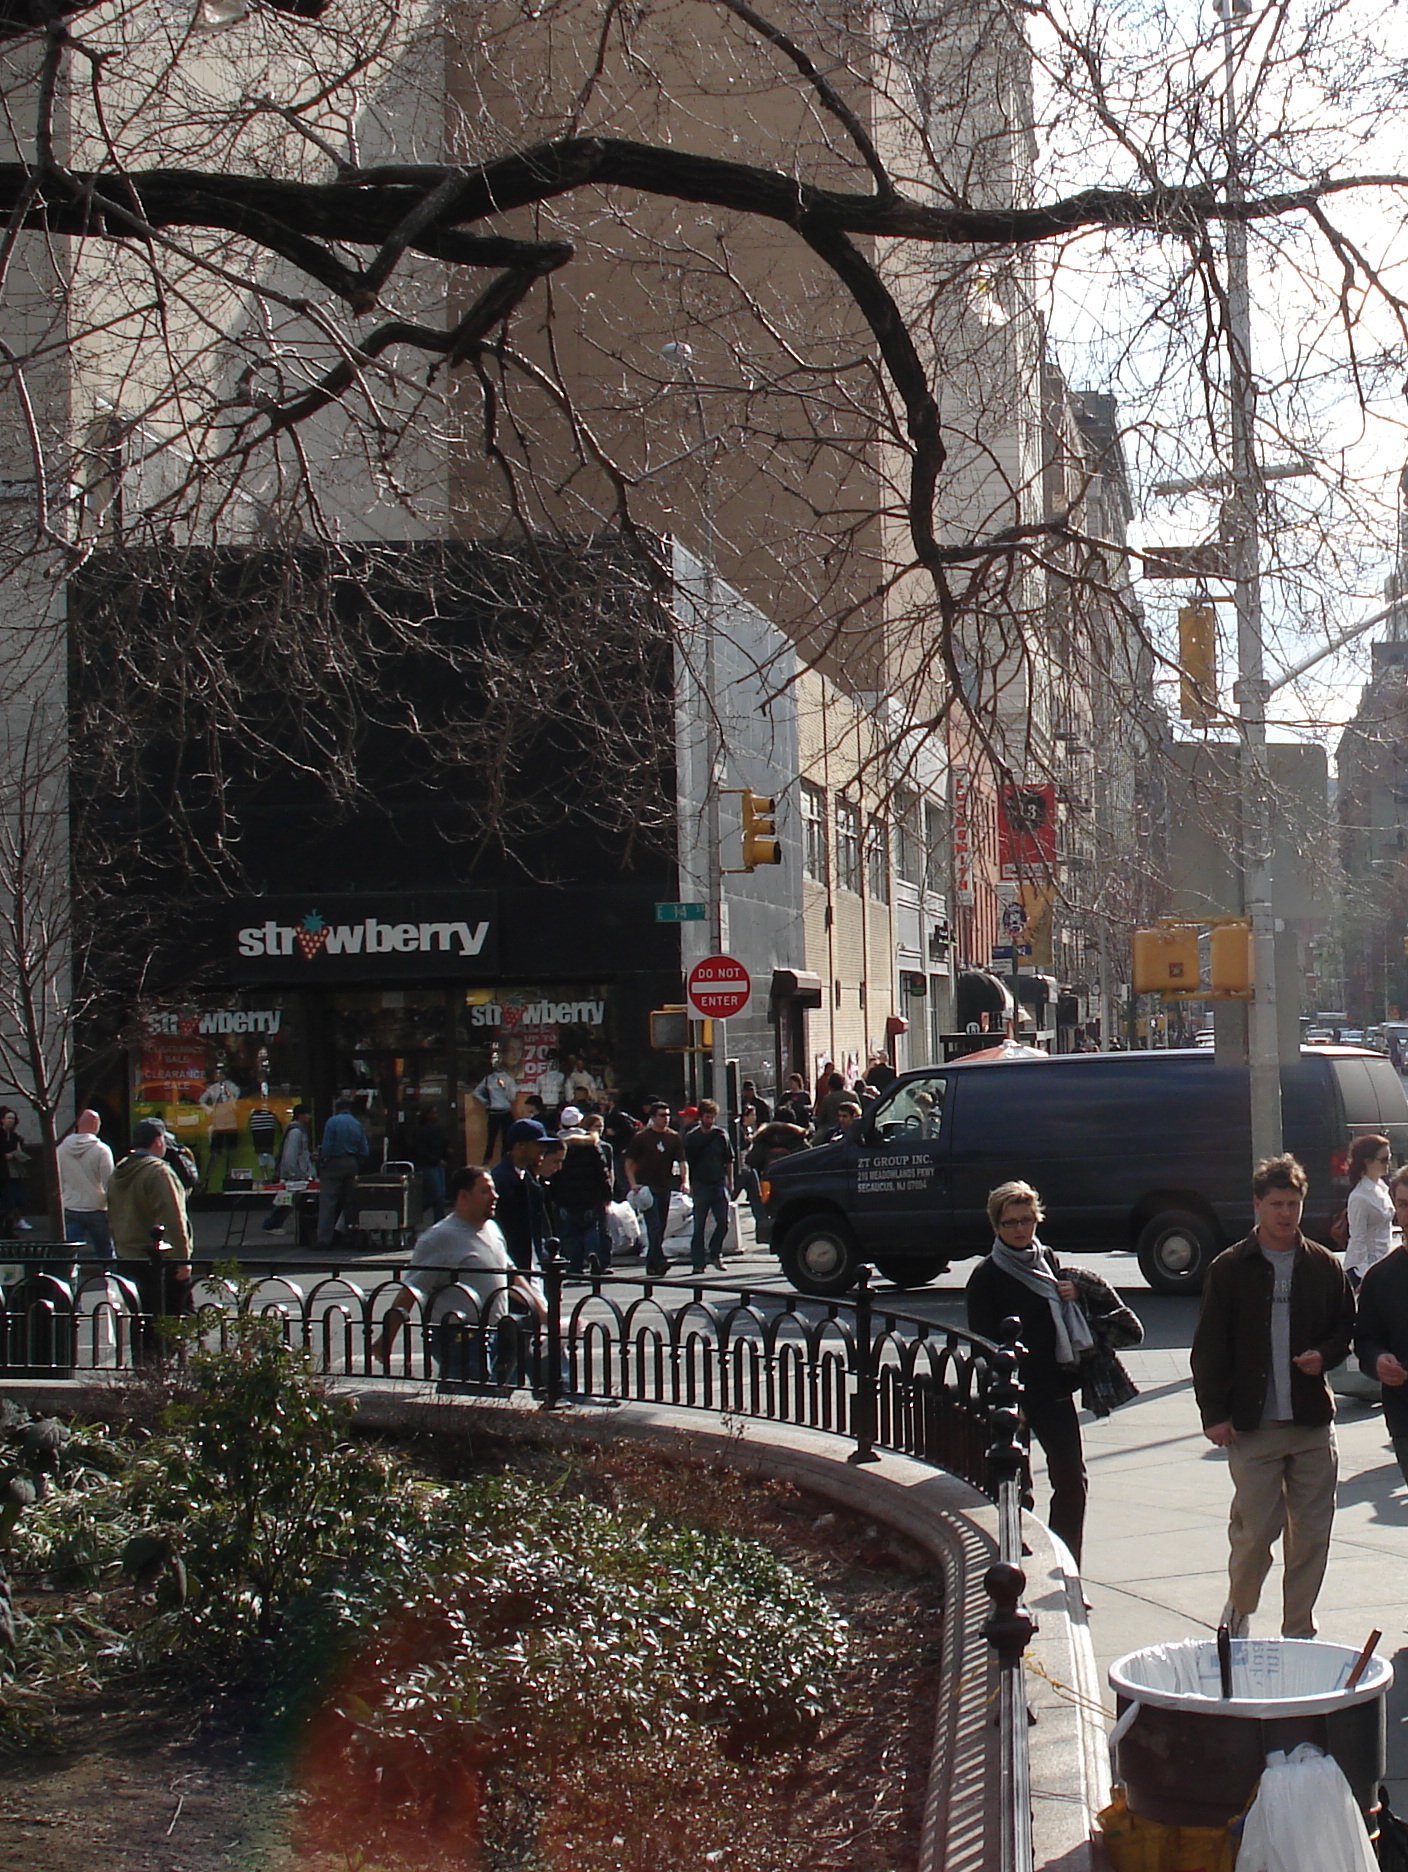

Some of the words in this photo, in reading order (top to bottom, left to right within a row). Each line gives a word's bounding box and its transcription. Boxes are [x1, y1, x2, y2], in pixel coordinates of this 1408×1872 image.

[674, 905, 687, 919] 14
[698, 968, 713, 979] DO
[718, 967, 740, 978] NOT
[701, 995, 738, 1007] ENTER
[145, 1069, 207, 1079] CLEARANCE
[163, 1080, 190, 1090] SALE
[873, 1156, 910, 1167] GROUP
[912, 1154, 933, 1165] INC.
